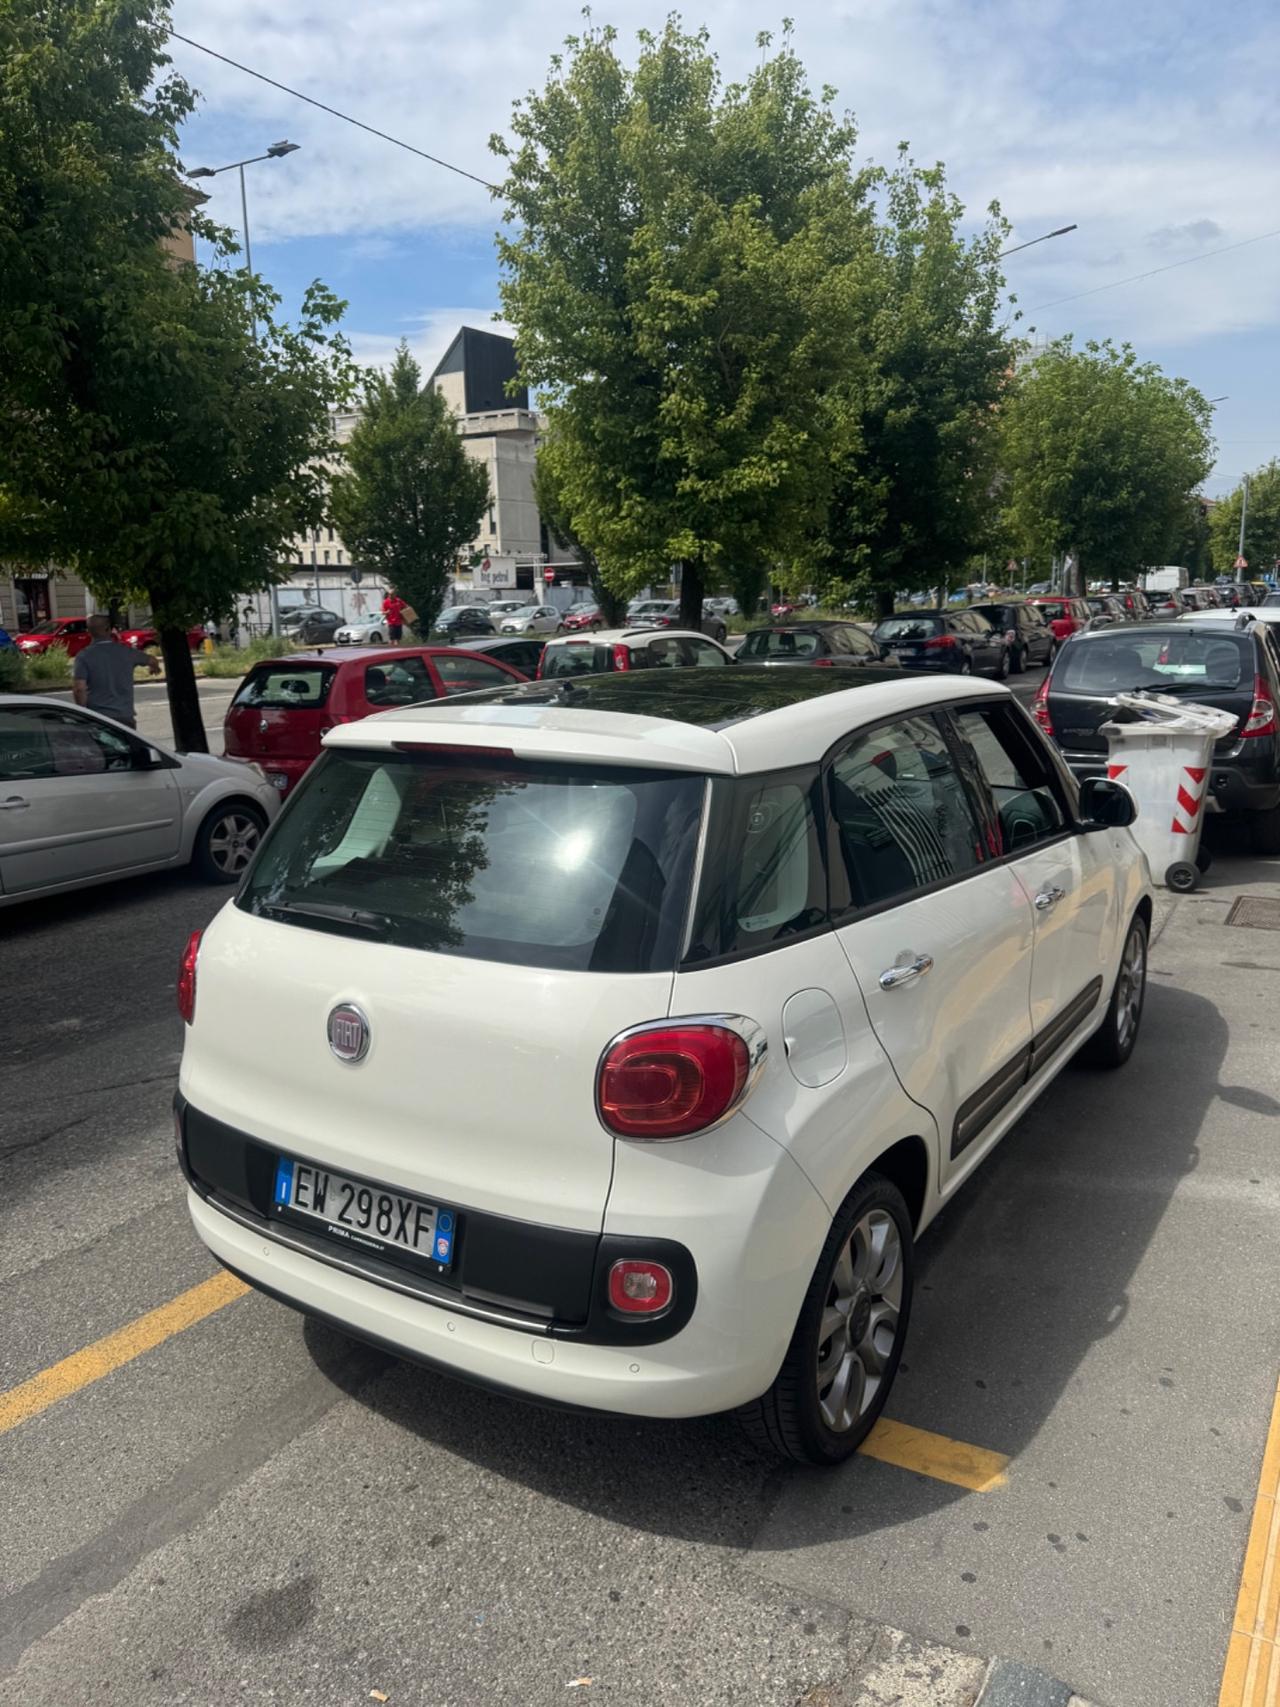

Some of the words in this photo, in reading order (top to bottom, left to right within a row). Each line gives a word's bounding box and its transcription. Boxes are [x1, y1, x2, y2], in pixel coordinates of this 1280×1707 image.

[336, 1019, 360, 1048] FIAT
[295, 1166, 329, 1213] EW
[338, 1183, 433, 1247] 298XF
